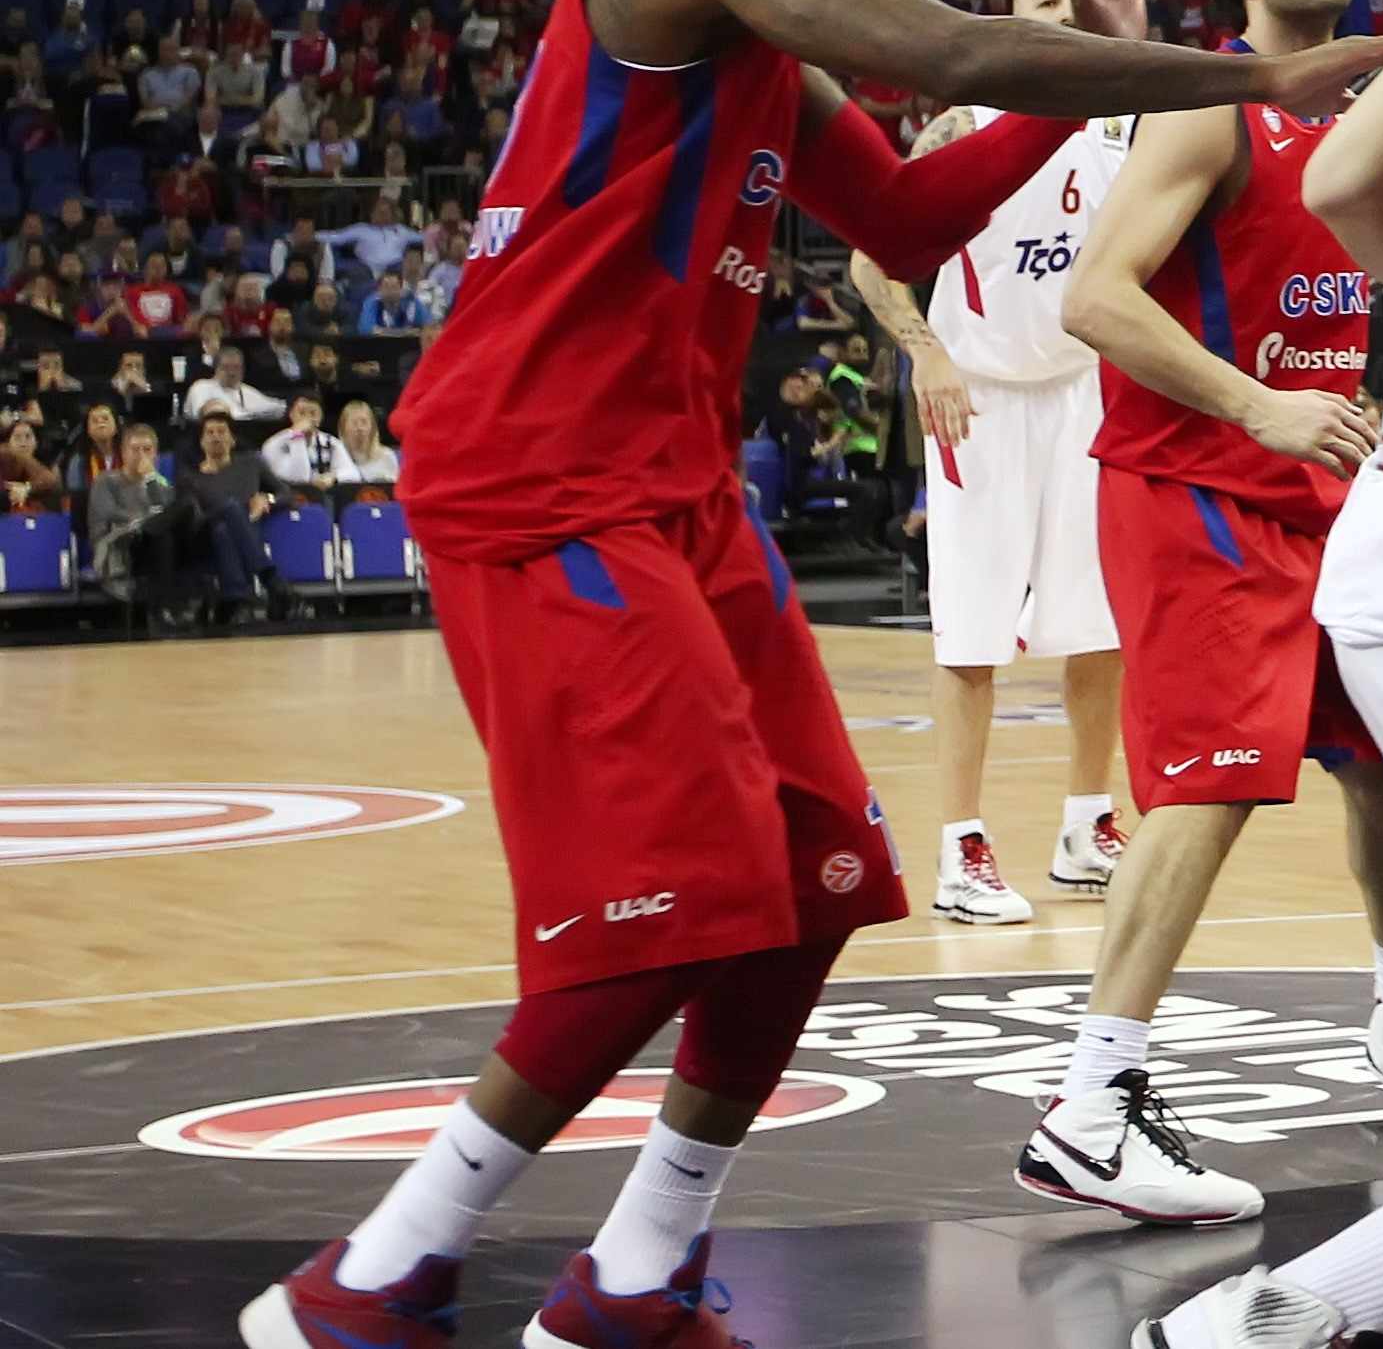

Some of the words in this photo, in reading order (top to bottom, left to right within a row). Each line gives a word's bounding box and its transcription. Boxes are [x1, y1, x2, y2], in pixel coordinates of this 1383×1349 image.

[1062, 169, 1080, 214] 6
[1212, 748, 1262, 767] UAC
[604, 891, 676, 922] UAC
